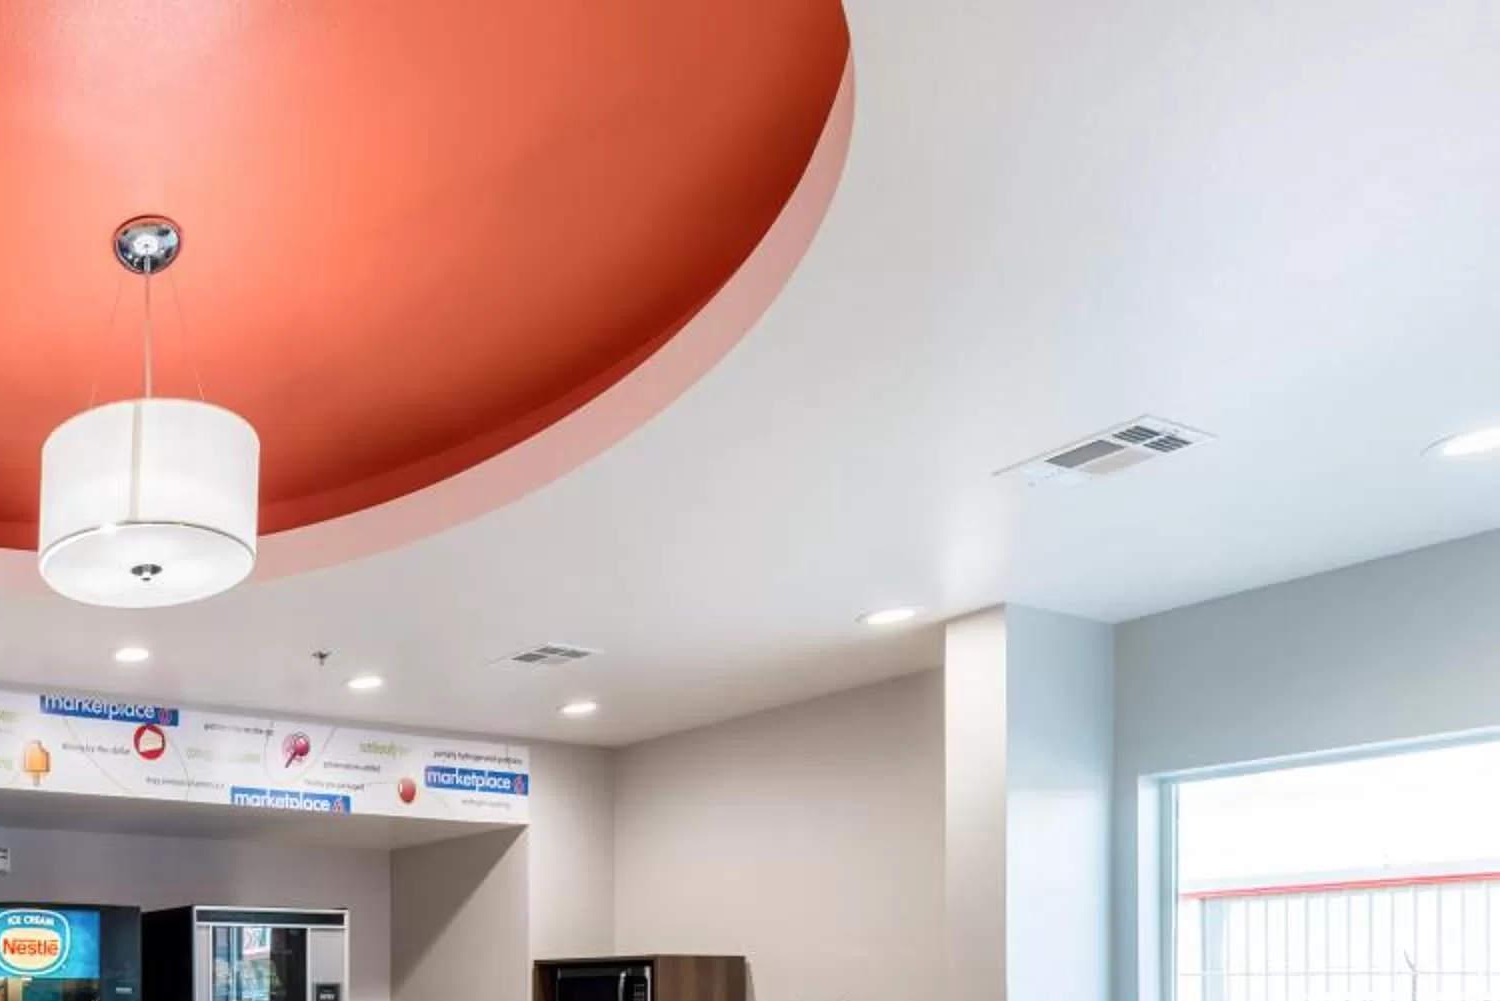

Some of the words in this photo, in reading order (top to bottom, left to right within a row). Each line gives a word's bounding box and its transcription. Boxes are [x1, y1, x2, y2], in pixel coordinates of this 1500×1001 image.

[45, 695, 156, 721] marketplace
[427, 767, 512, 793] marketplace
[234, 788, 331, 812] marketplace
